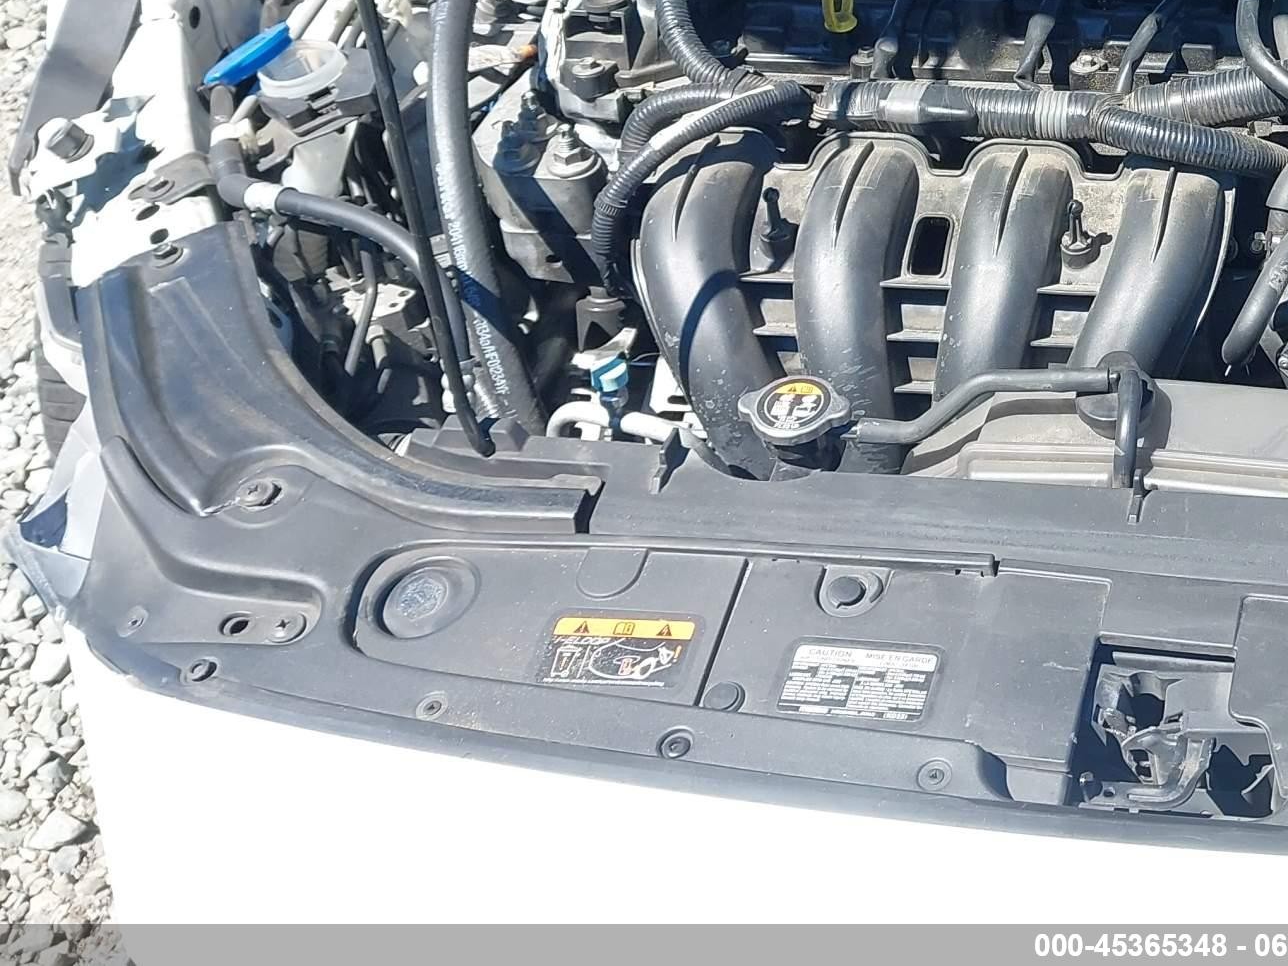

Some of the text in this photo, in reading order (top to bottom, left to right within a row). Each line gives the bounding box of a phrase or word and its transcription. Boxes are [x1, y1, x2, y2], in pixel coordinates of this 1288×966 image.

[808, 648, 853, 658] CAUTION
[865, 652, 886, 660] MISE
[888, 654, 902, 662] EN
[903, 655, 933, 664] GARDE
